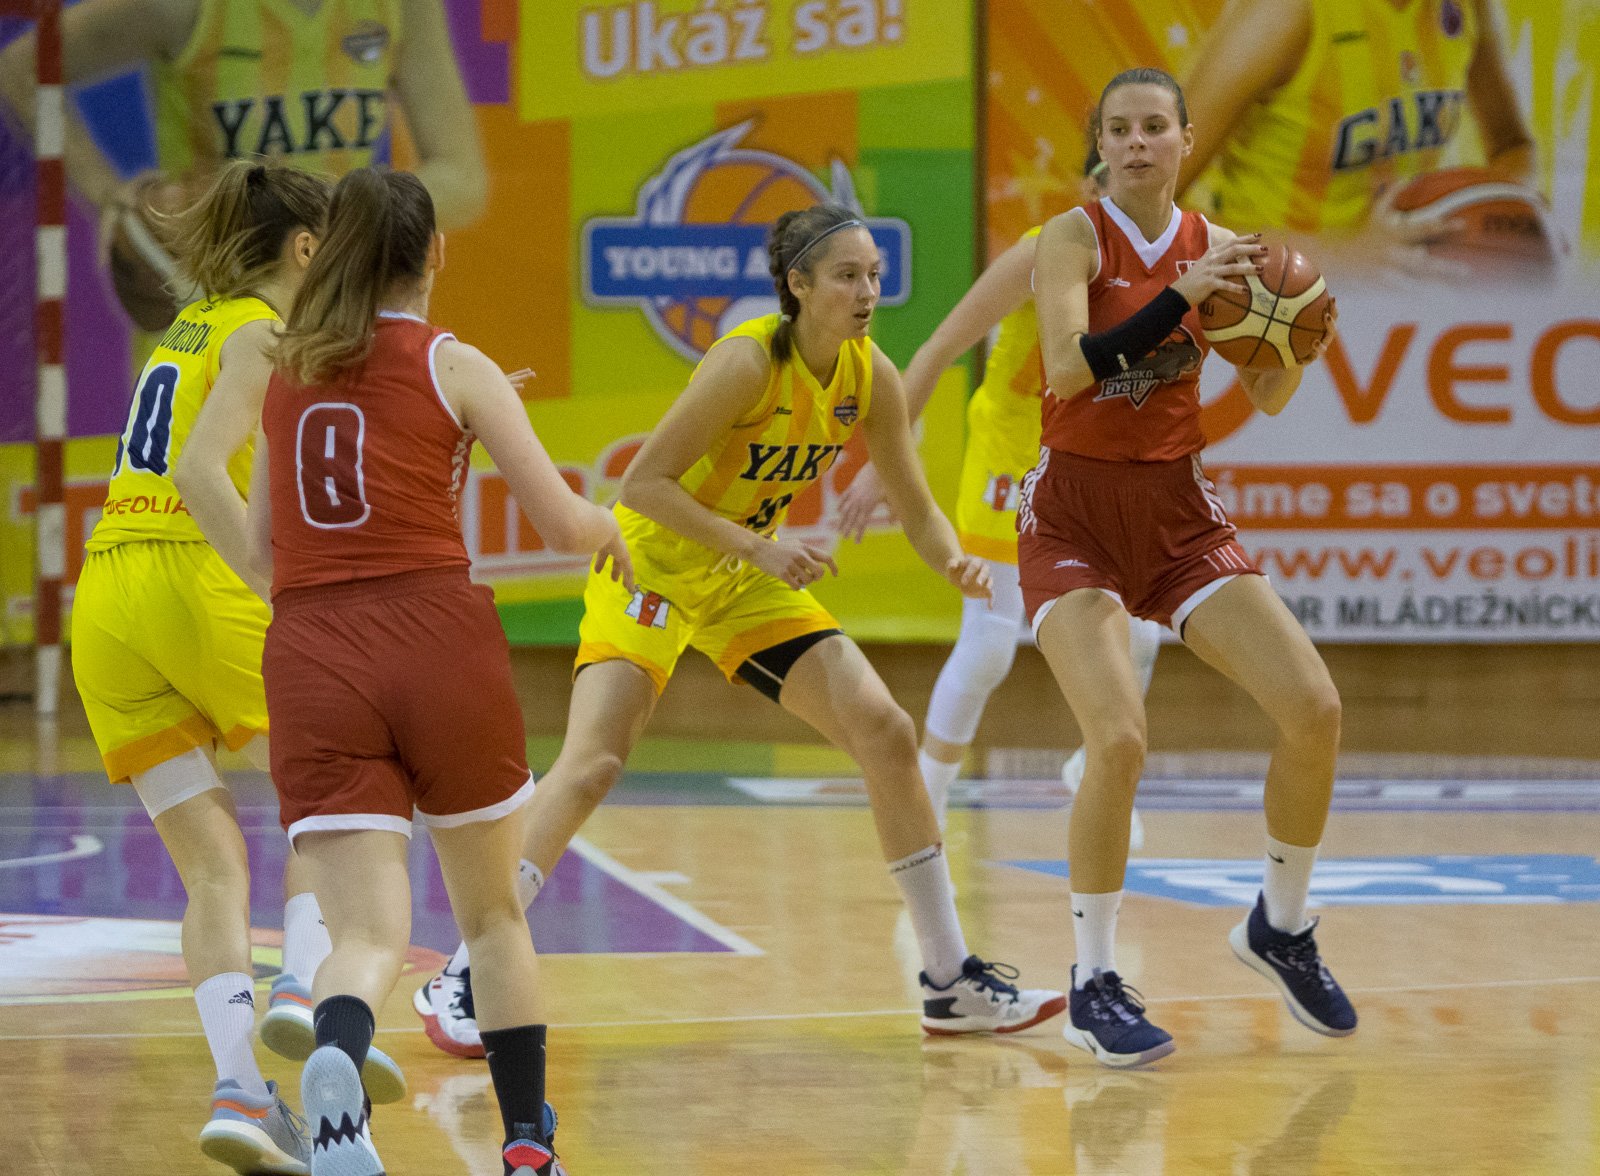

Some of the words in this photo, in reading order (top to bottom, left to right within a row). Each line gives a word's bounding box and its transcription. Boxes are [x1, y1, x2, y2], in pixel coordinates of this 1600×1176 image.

[794, 0, 901, 51] sa!
[605, 246, 739, 280] YOUNG
[296, 402, 371, 528] 8
[1345, 482, 1411, 518] sa
[1425, 482, 1461, 518] o
[1472, 475, 1600, 518] svet
[1337, 585, 1600, 628] MLÁDEŽNÍCK
